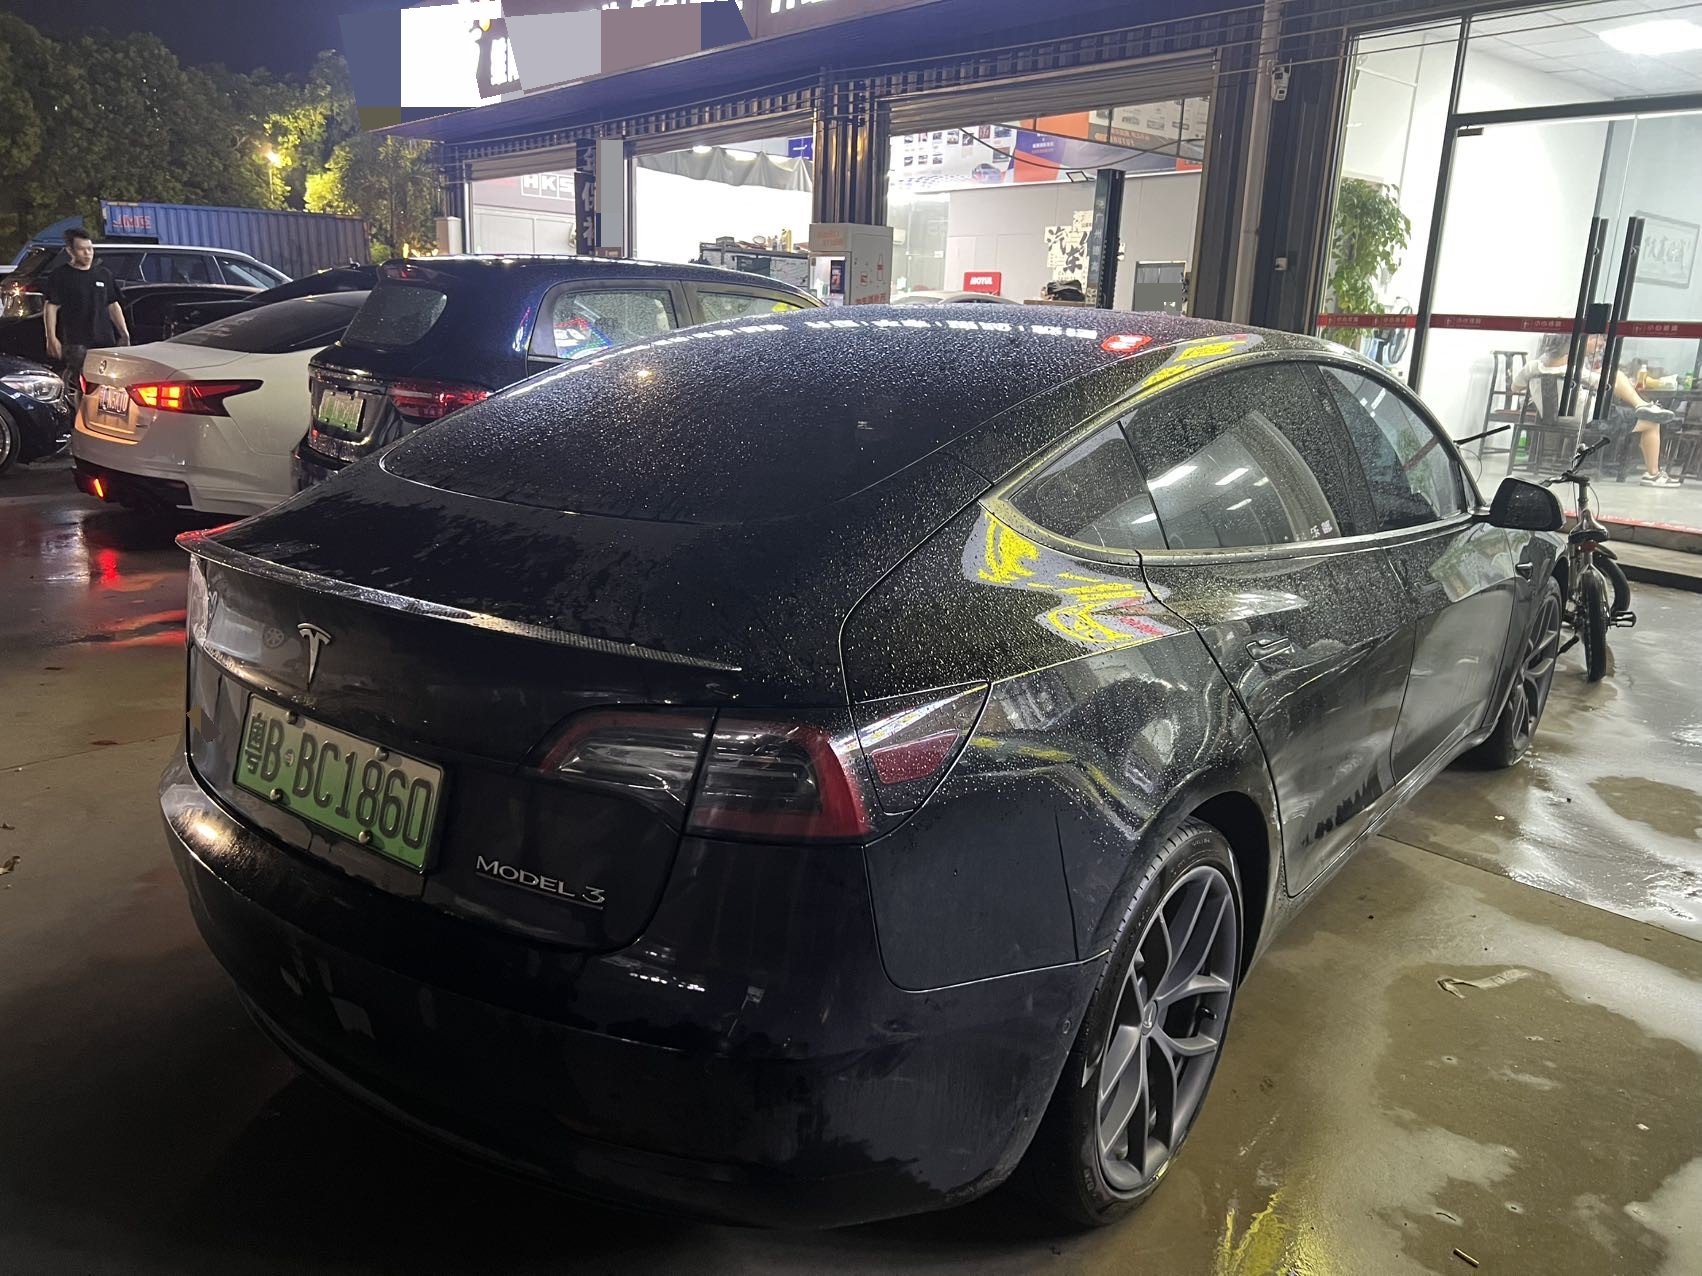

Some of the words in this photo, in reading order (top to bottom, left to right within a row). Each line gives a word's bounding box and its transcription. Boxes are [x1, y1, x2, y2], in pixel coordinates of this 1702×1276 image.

[969, 276, 993, 285] MOTUL
[476, 855, 576, 897] MODEL
[582, 885, 605, 904] 3
